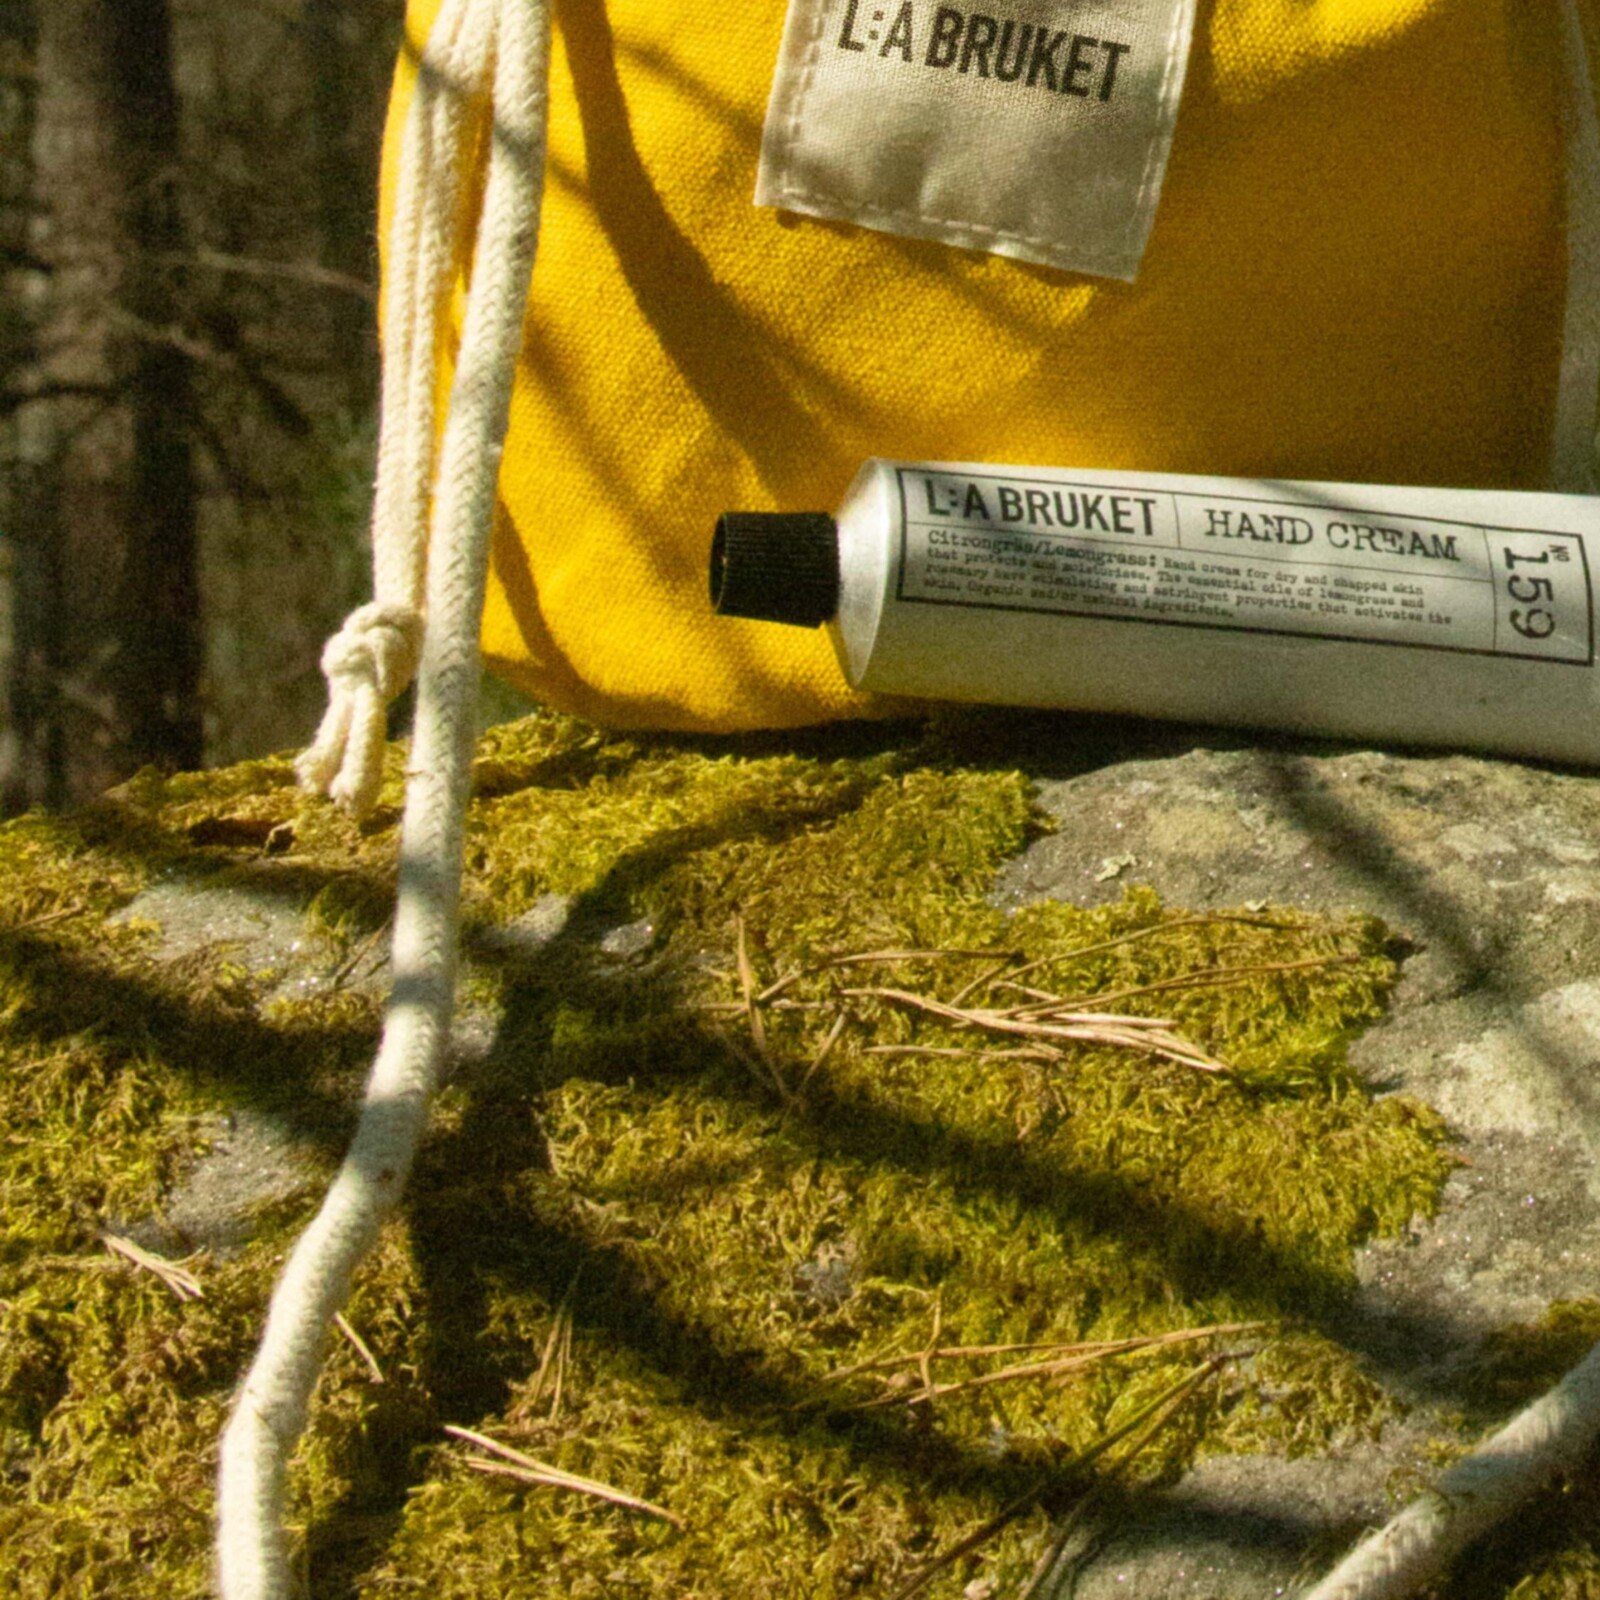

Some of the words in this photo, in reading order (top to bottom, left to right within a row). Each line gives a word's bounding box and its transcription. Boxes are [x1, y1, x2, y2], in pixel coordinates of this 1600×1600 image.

[925, 6, 1131, 101] BRUKET
[925, 478, 990, 520] L:A
[998, 486, 1157, 536] BRUKET
[1204, 509, 1313, 545] HAND
[1327, 521, 1461, 561] CREAM
[926, 547, 958, 560] that
[965, 553, 1027, 567] protects
[1156, 570, 1181, 583] The
[1187, 575, 1256, 591] essential
[1261, 583, 1292, 595] oils
[1298, 587, 1313, 597] of
[1401, 598, 1424, 608] and
[1164, 557, 1197, 571] Hand
[1202, 563, 1240, 576] cream
[1247, 568, 1269, 579] for
[1275, 571, 1298, 584] dry
[1304, 575, 1327, 585] and
[1503, 547, 1556, 639] 159
[1124, 583, 1147, 594] and
[1235, 594, 1312, 611] properties
[1318, 601, 1348, 614] that
[1428, 611, 1452, 624] the
